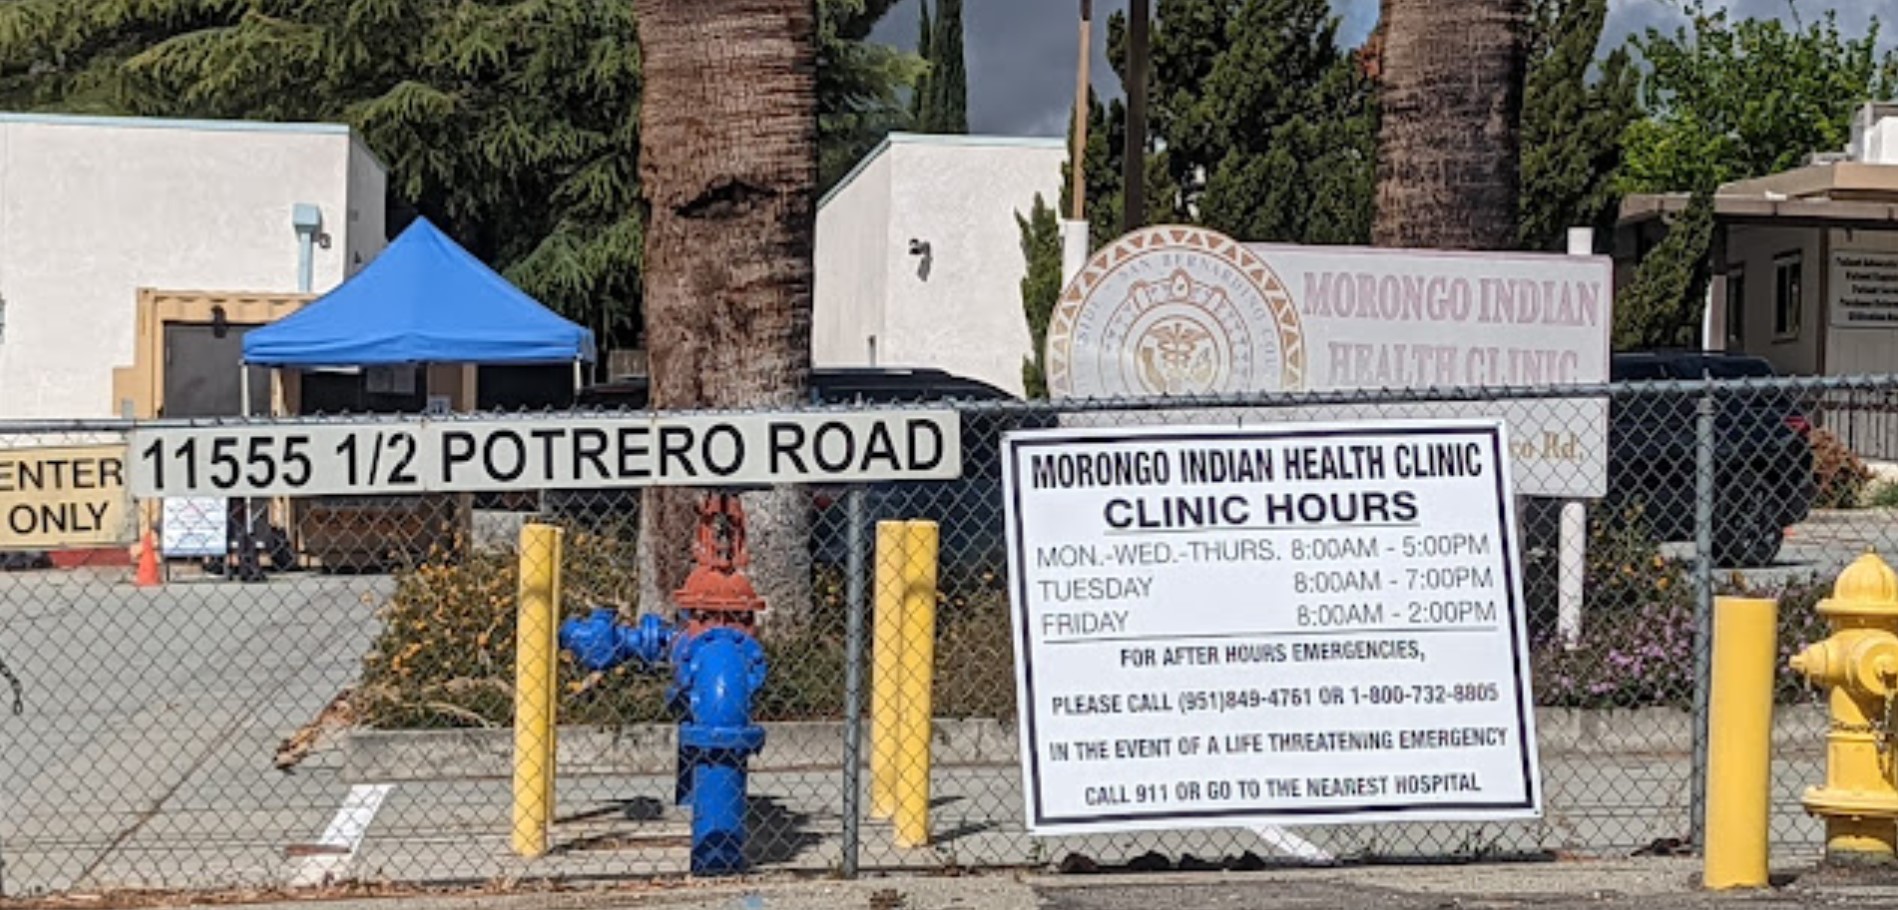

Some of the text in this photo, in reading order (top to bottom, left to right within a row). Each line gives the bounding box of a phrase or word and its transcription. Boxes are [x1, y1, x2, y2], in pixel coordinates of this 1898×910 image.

[1303, 272, 1600, 326] MORONGO INDIAN
[1328, 341, 1578, 386] HEALTH CLINIC
[143, 417, 944, 490] 11555 1/2 POTRERO ROAD
[1031, 449, 1170, 489] MORONGO
[1179, 447, 1274, 483] INDIAN
[1283, 444, 1385, 480] HEALTH
[1394, 441, 1482, 477] CLINIC
[0, 458, 123, 491] ENTER
[9, 502, 109, 535] ONLY
[1103, 491, 1419, 529] CLINIC HOURS
[1036, 537, 1281, 568] MON.-WED.-THURS.
[1291, 536, 1379, 561] 8:00AM
[1402, 533, 1490, 557] 5:00PM
[1037, 576, 1153, 602] TUESDAY
[1294, 569, 1381, 594] 8:00AM
[1405, 566, 1493, 590] 7:00PM
[1042, 610, 1129, 636] FRIDAY
[1297, 602, 1383, 627] 8:00AM
[1408, 600, 1497, 624] 2:00PM
[1120, 640, 1426, 668] FOR AFTER HOURS EMERGENCIES,
[1052, 682, 1499, 715] PLEASE CALL (951)849-4761 OR 1-800-732-8805
[1050, 727, 1507, 761] IN THE EVENT OF A LIFE THREATENING EMERGENCY
[1085, 772, 1482, 806] CALL 911 OR GO TO THE NEAREST HOSPITAL
